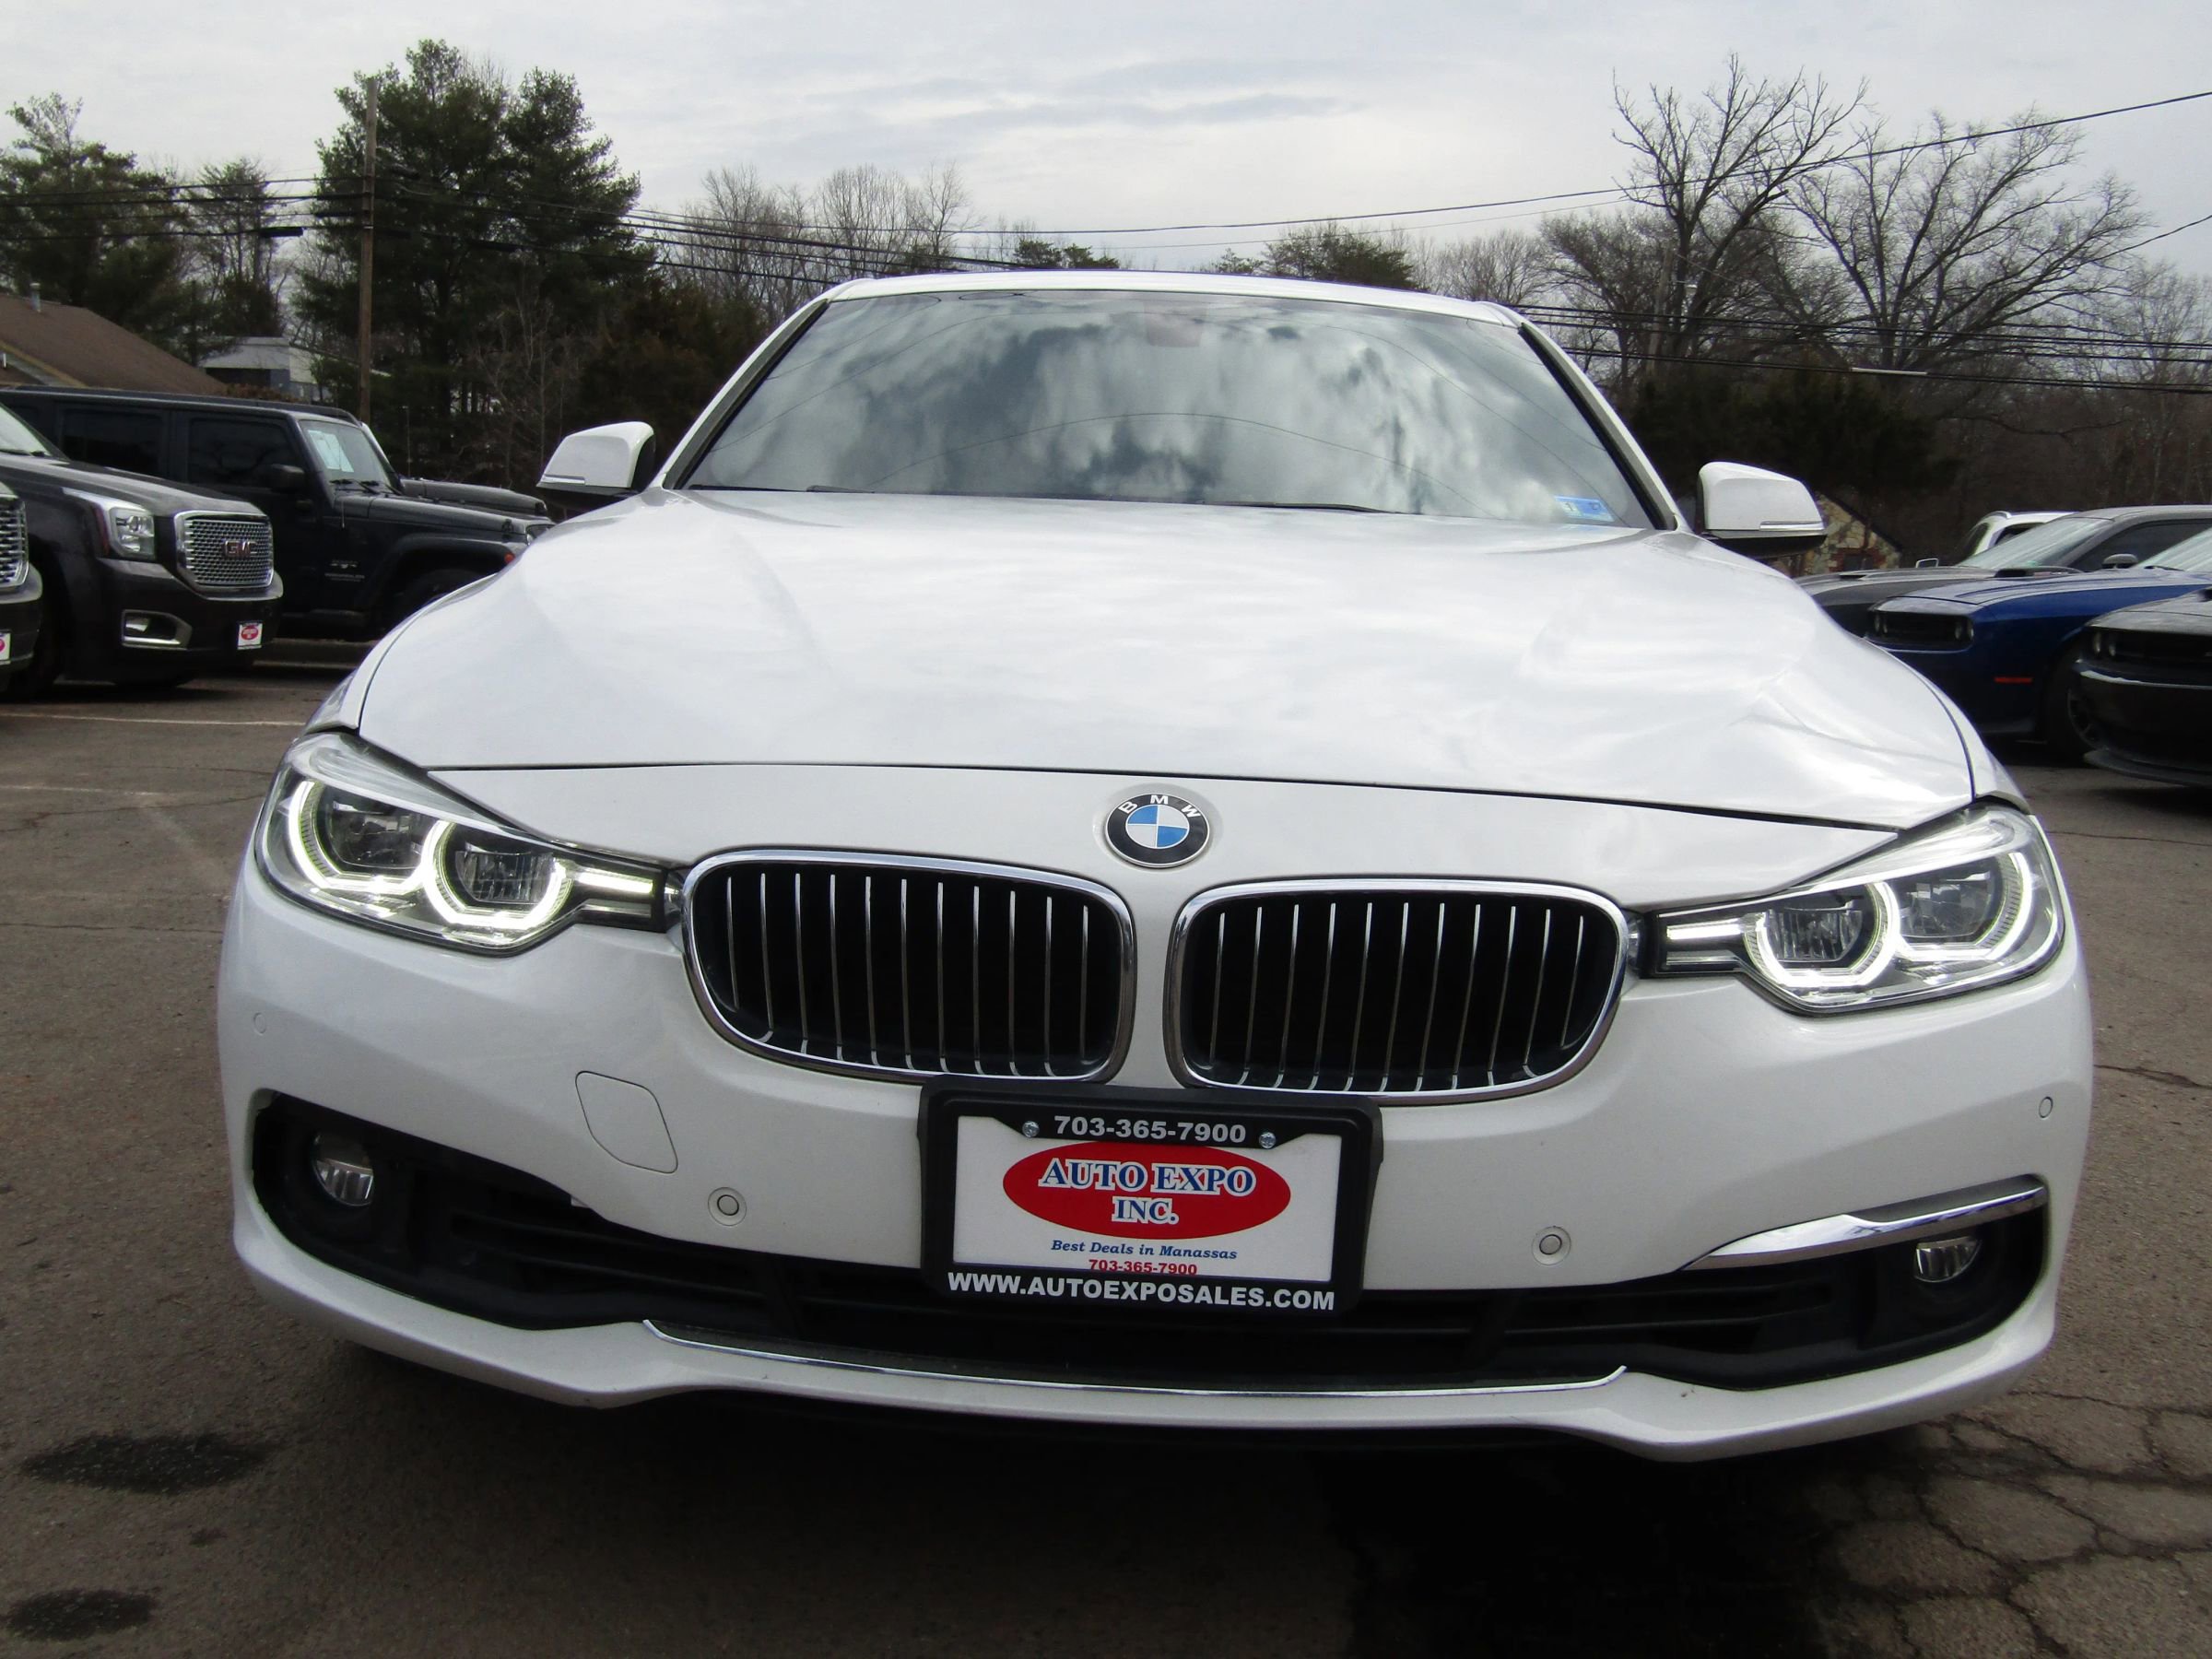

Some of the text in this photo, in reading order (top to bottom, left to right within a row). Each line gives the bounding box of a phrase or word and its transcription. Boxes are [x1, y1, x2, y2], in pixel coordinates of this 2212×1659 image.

[1118, 794, 1201, 818] BMW
[1054, 1115, 1246, 1143] 703-365-7900
[1041, 1159, 1256, 1195] AUTO EXPO
[1112, 1196, 1179, 1224] INC.
[1051, 1240, 1237, 1259] Best Deals in Manassas
[1088, 1259, 1197, 1276] 703-365-7900
[947, 1272, 1335, 1311] WWW.AUTOEXPOSALES.COM
